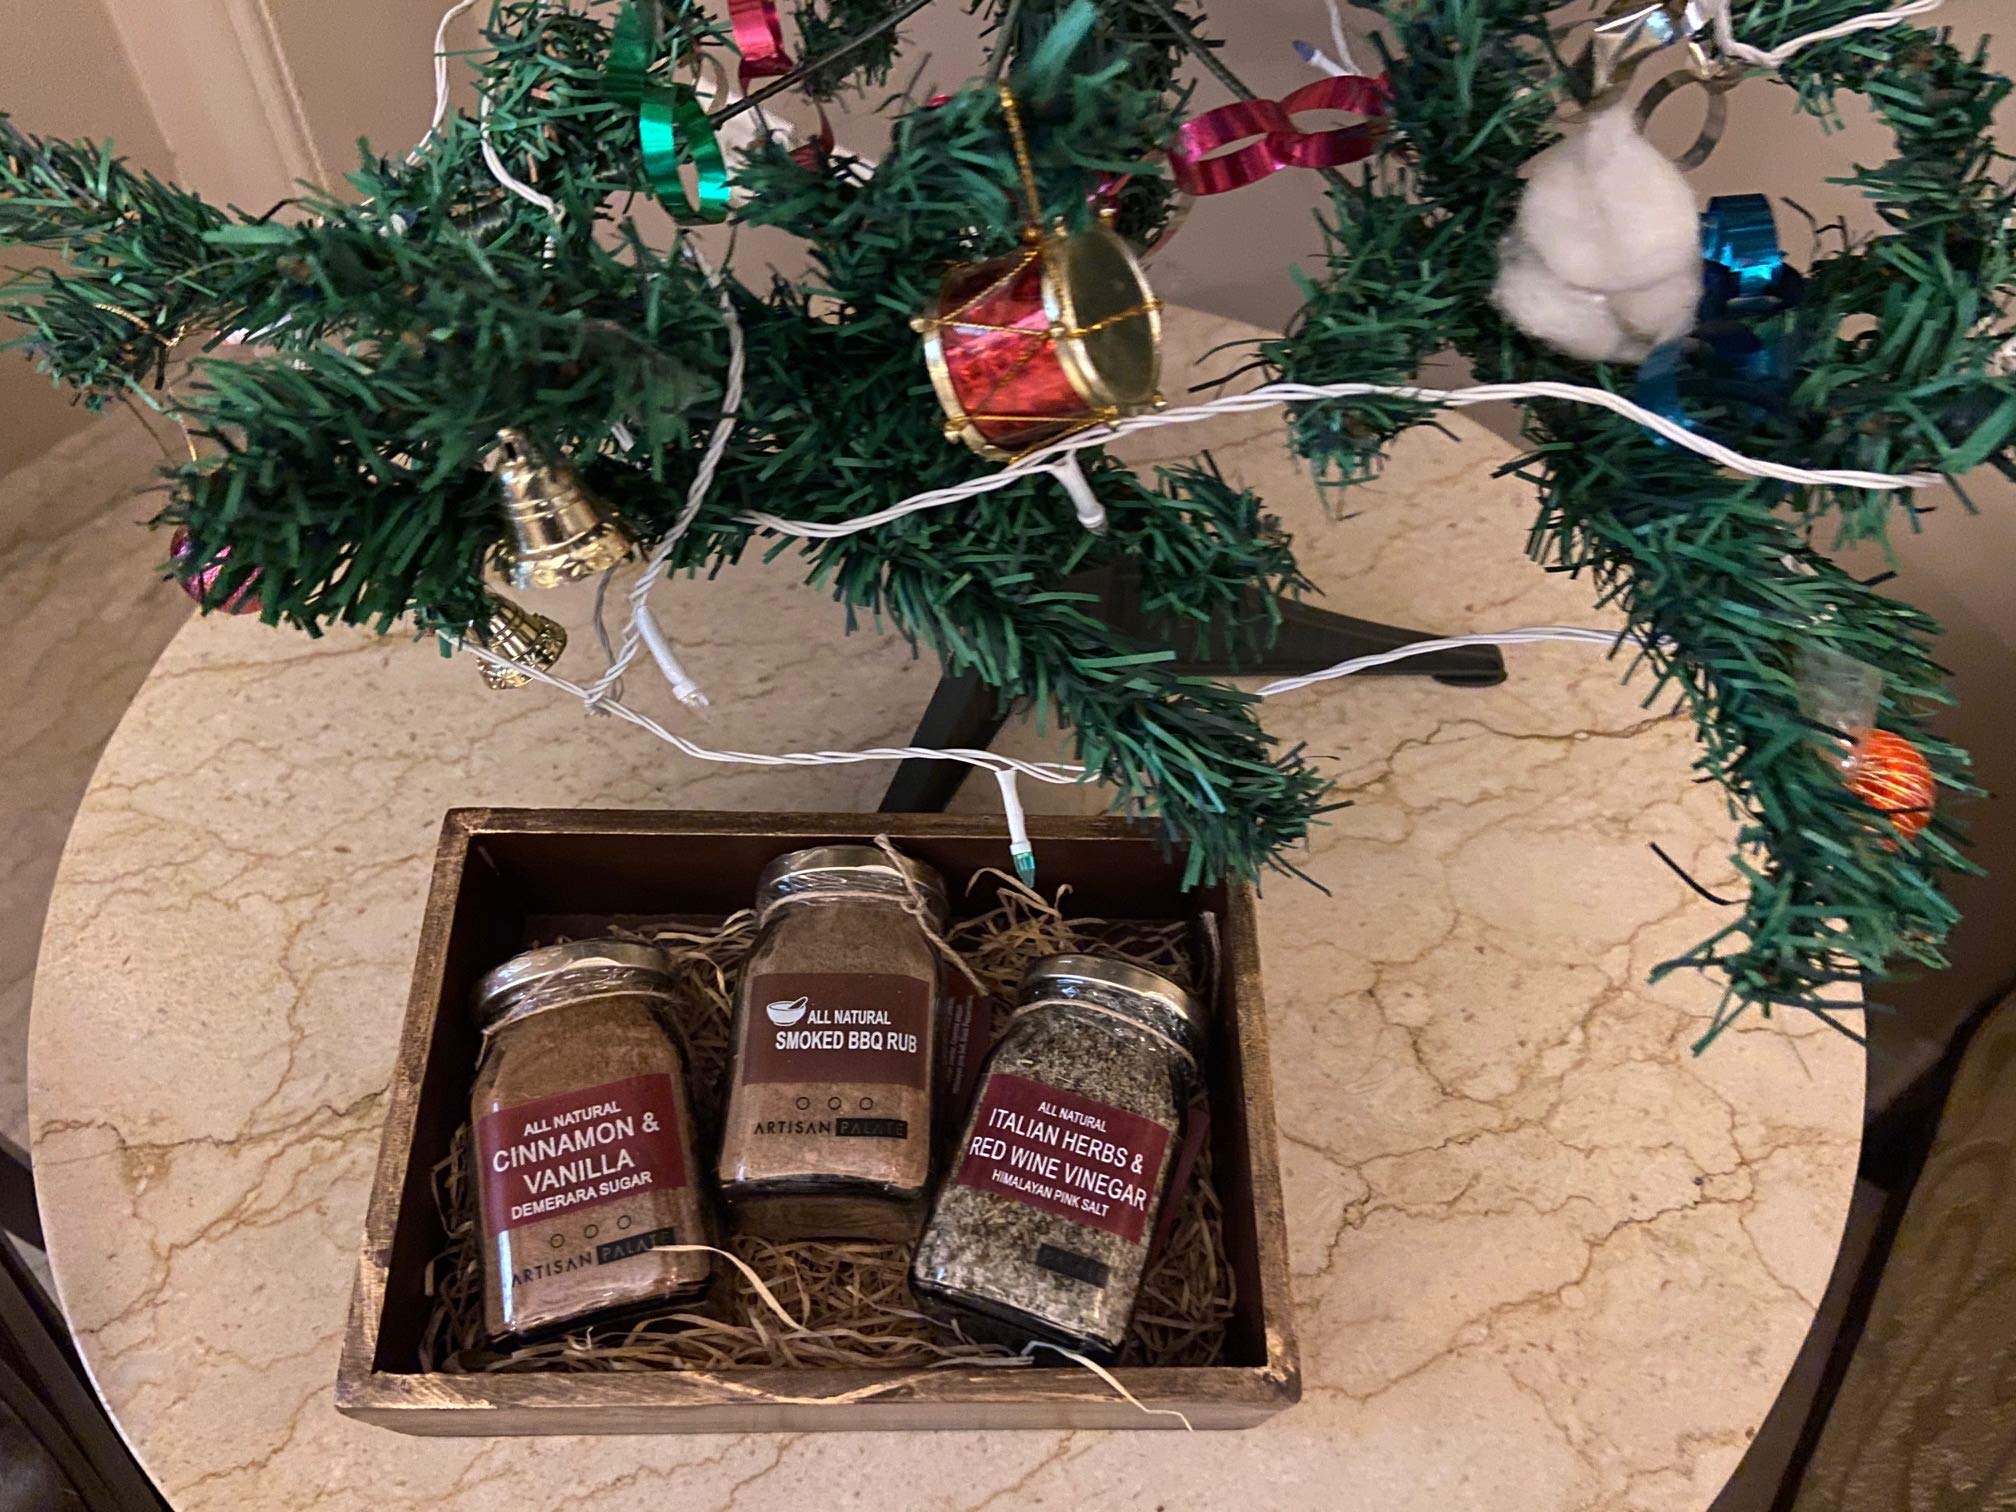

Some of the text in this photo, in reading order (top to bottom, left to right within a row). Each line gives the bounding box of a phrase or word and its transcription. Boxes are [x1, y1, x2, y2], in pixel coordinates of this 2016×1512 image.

[807, 1010, 891, 1025] ALL NATURAL
[775, 1031, 917, 1053] SMOKED BBQ RUB
[524, 1101, 621, 1136] ALL NATURAL
[754, 1121, 831, 1134] ARTISAN
[1038, 1101, 1107, 1133] ALL NATURAL
[492, 1112, 660, 1173] CINNAMON &
[988, 1108, 1143, 1175] ITALIAN HERBS &
[523, 1148, 635, 1195] VANILLA
[969, 1136, 1147, 1211] RED WINE VINEGAR
[511, 1171, 653, 1220] DEMERARA SUGAR
[991, 1169, 1110, 1217] HIMALAYAN PINK SALT
[512, 1252, 592, 1288] ARTISAN
